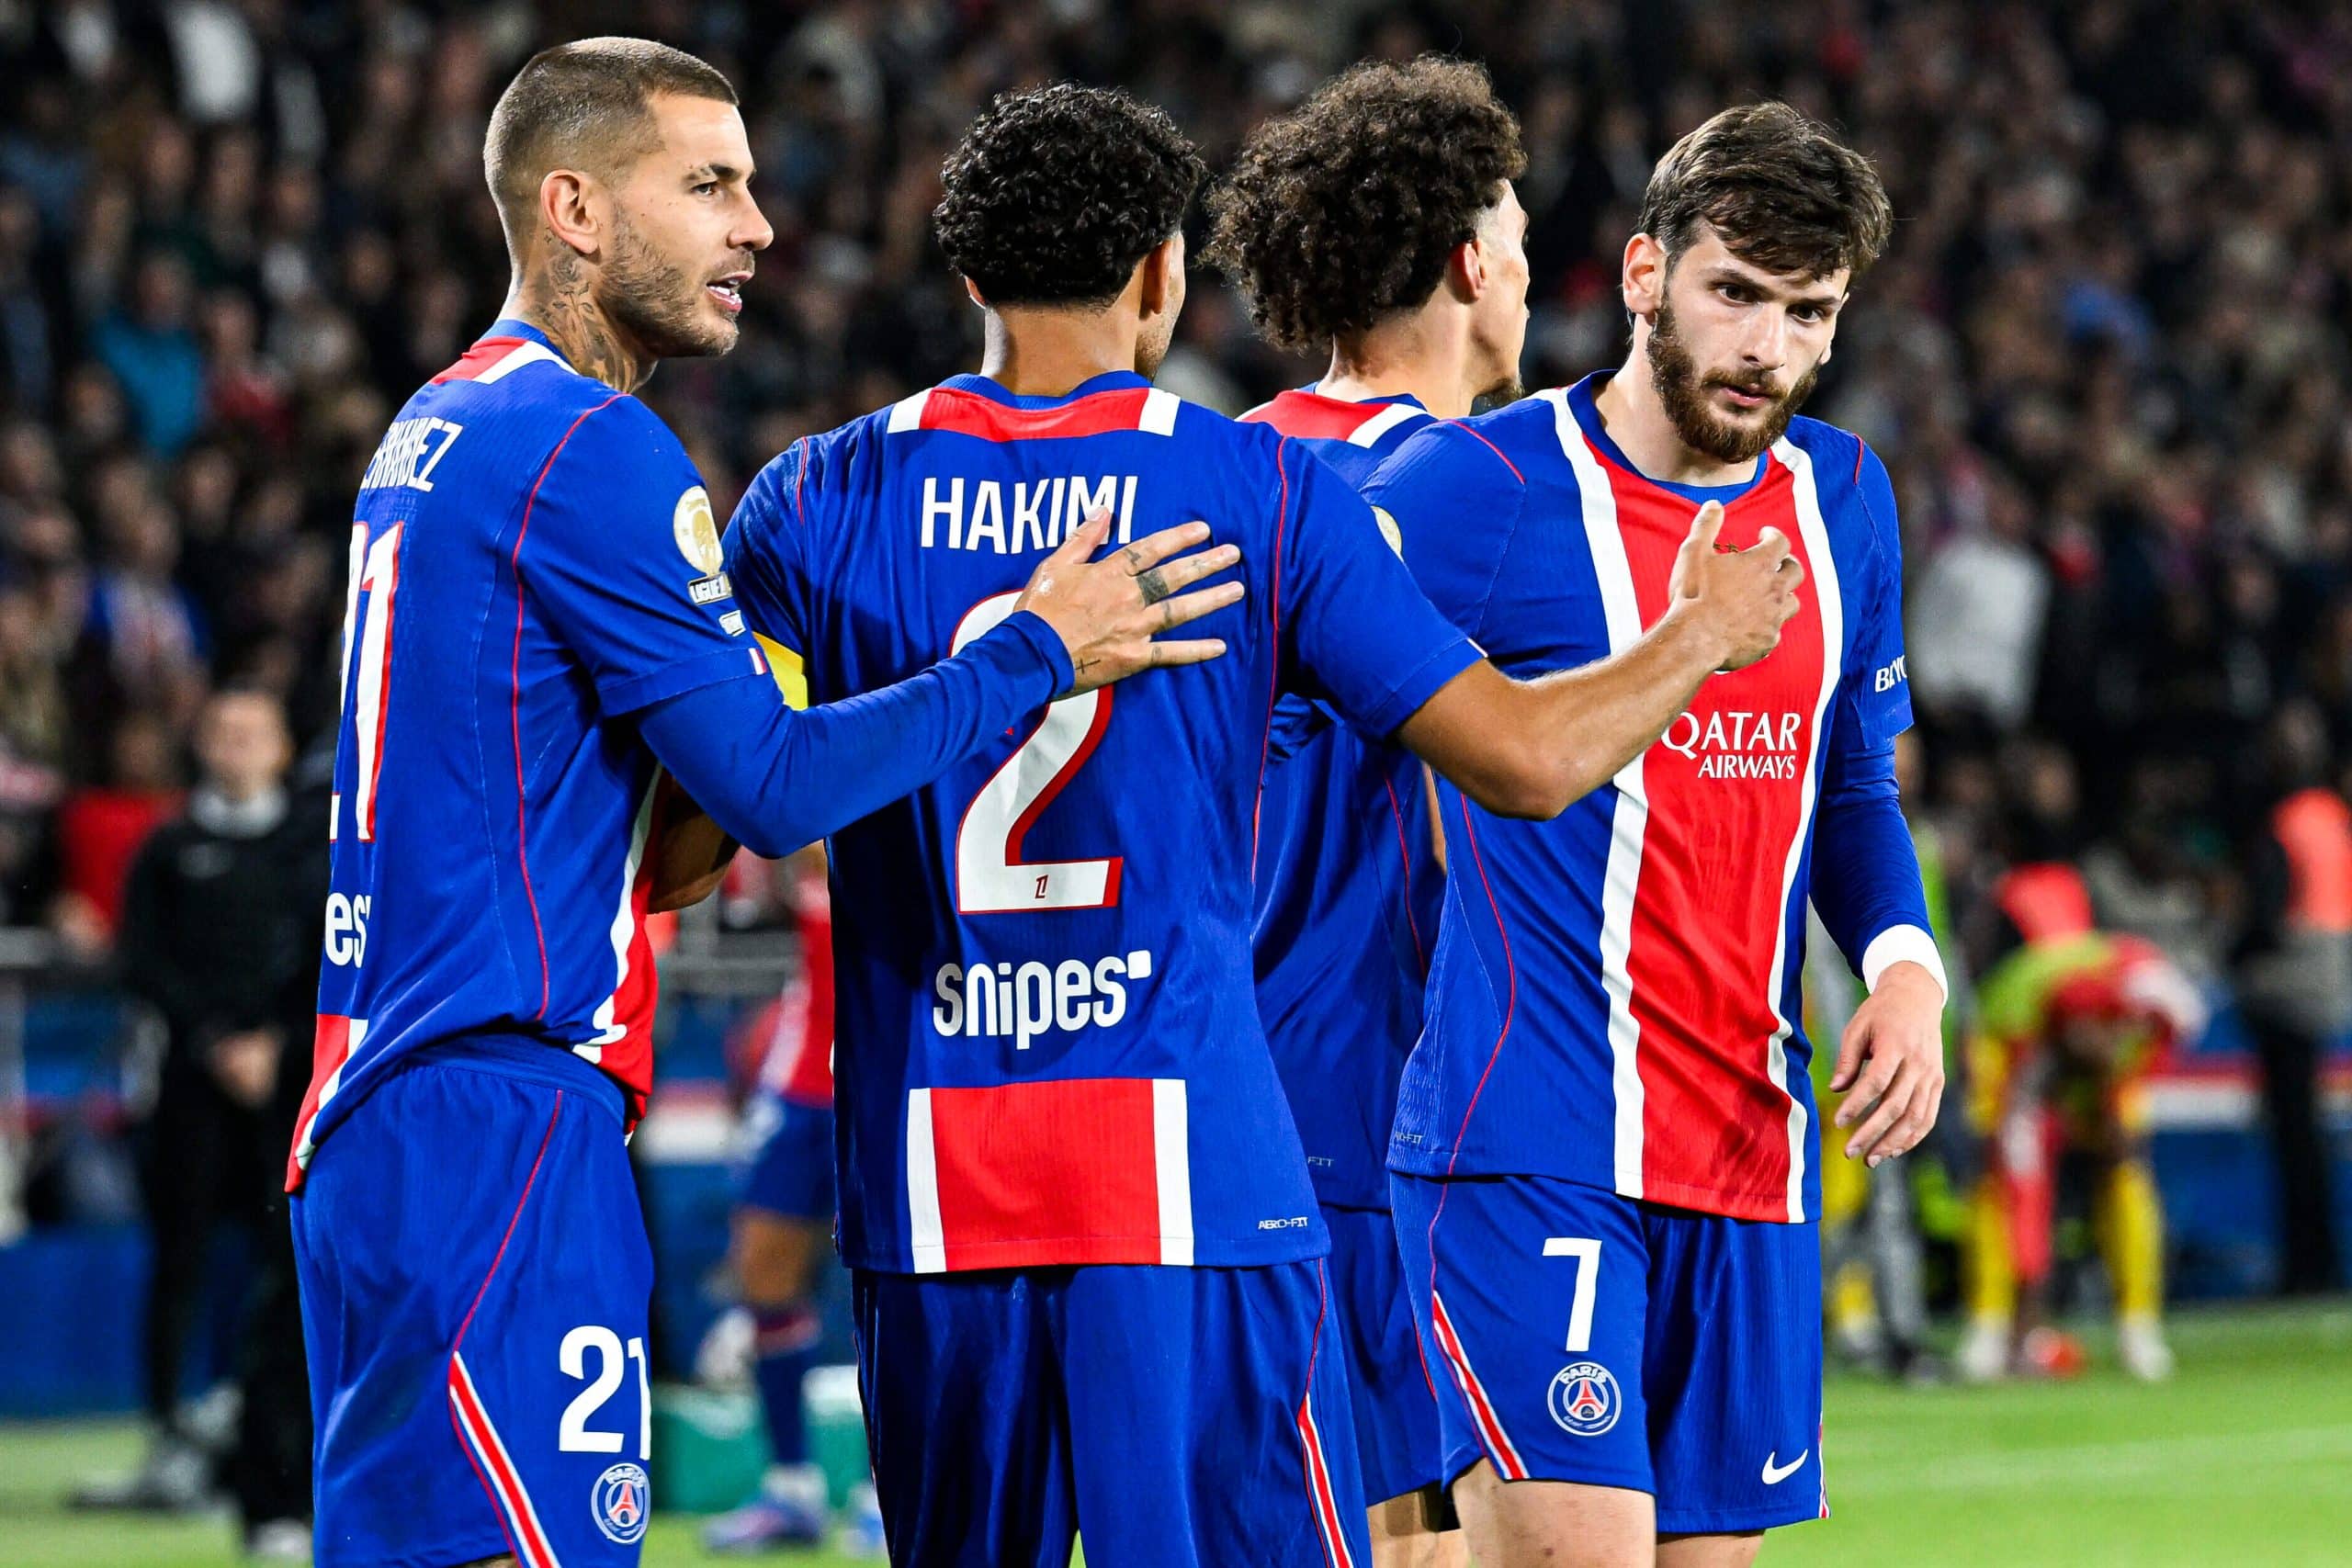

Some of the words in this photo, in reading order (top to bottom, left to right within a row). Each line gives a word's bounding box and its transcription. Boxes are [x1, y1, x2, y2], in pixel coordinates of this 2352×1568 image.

[921, 476, 1138, 555] HAKIMI
[949, 588, 1124, 915] 2
[1661, 711, 1801, 760] QATAR
[1698, 755, 1796, 779] AIRWAYS
[933, 956, 1126, 1050] snipes
[1543, 1237, 1602, 1351] 7
[559, 1325, 651, 1461] 21
[1559, 1366, 1607, 1384] PARIS
